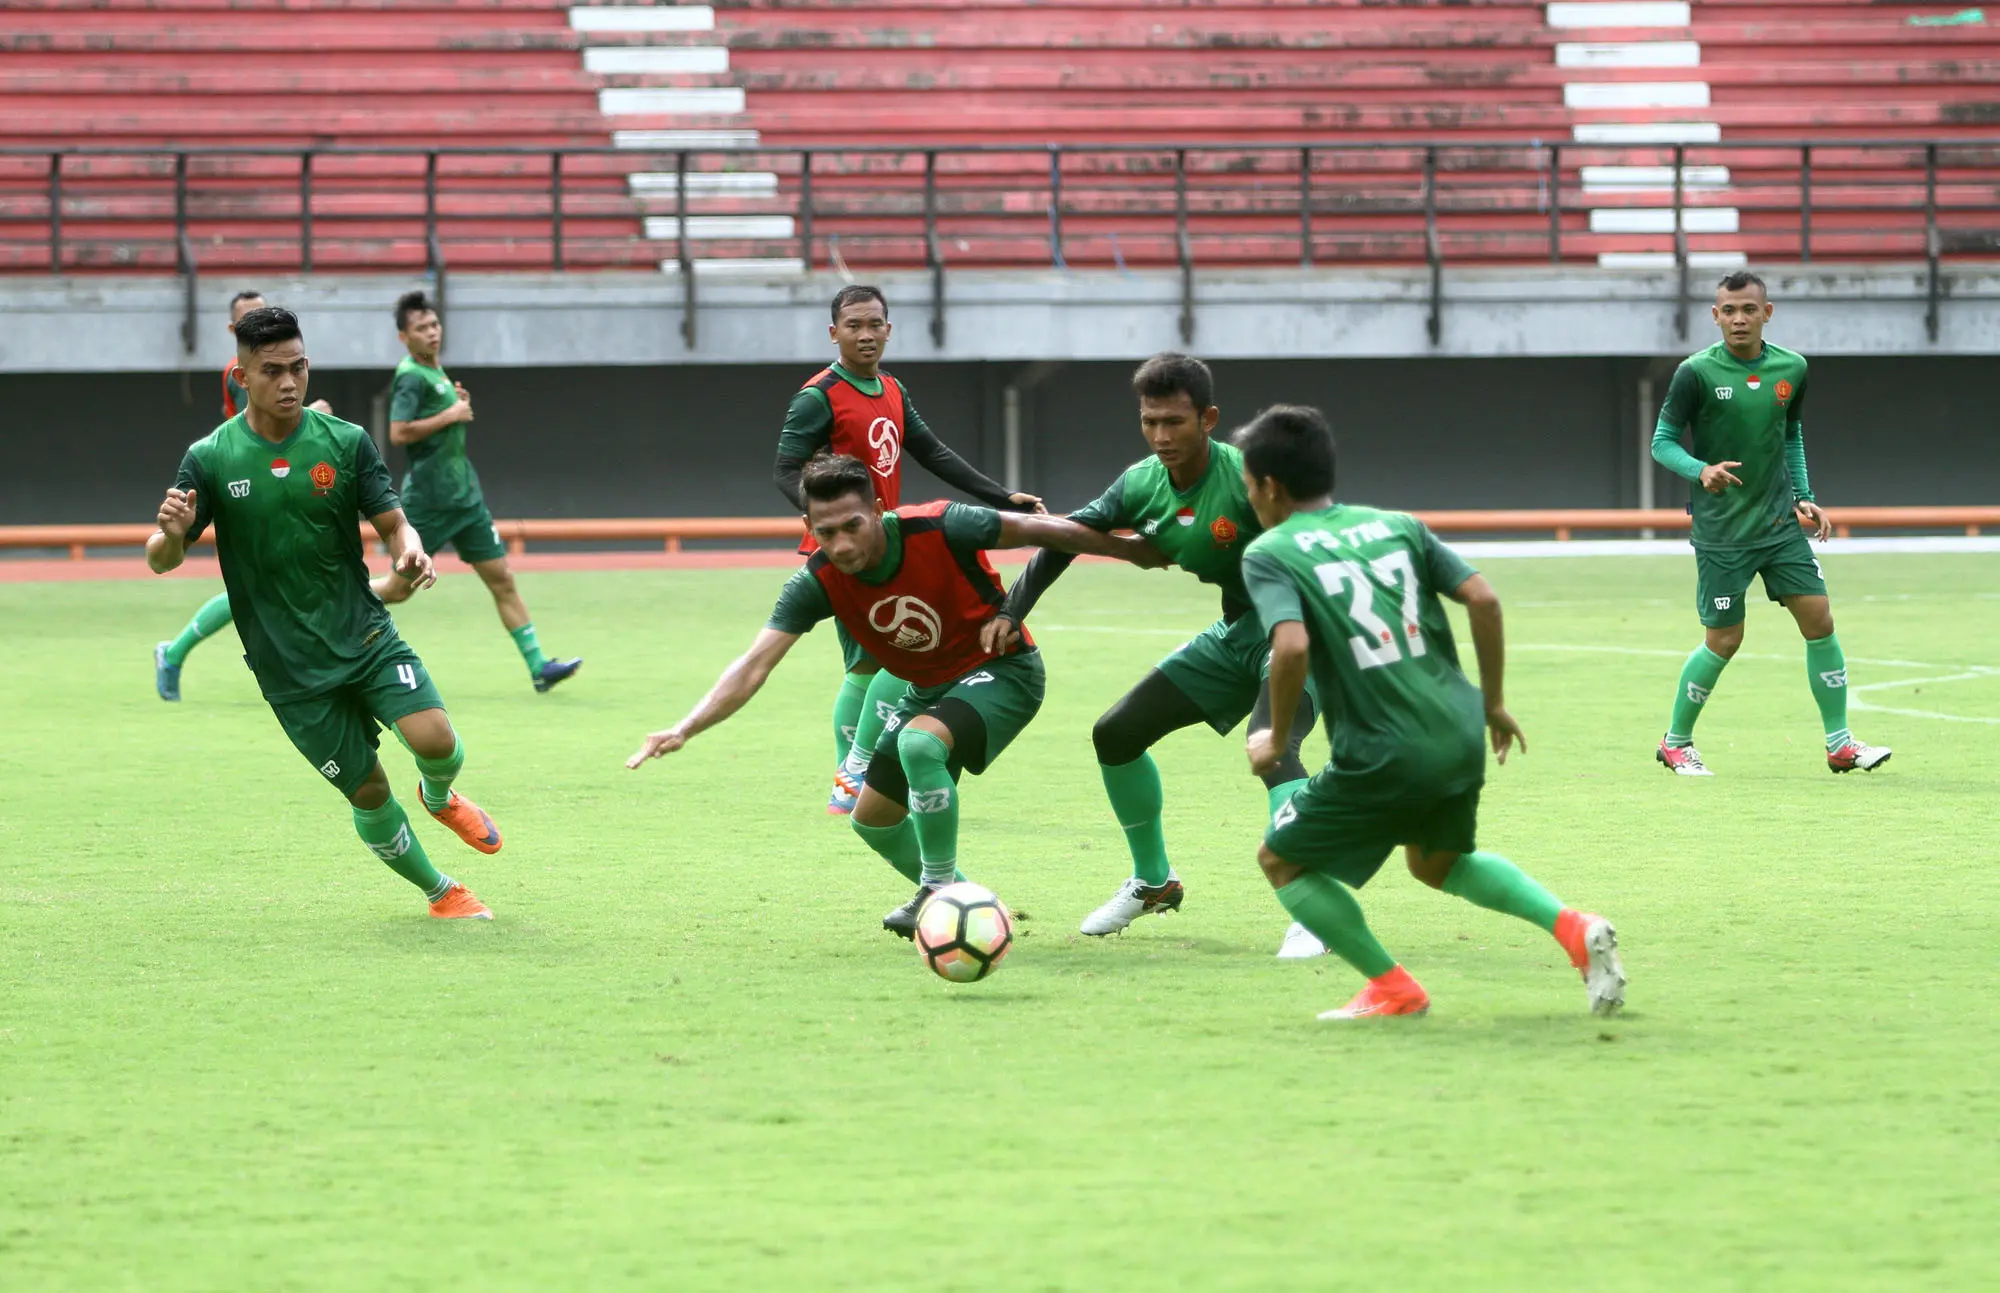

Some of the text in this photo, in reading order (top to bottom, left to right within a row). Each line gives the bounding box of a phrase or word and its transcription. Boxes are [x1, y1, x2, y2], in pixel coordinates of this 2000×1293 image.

[1313, 550, 1427, 671] 37
[396, 664, 417, 690] 4
[960, 670, 995, 686] 17
